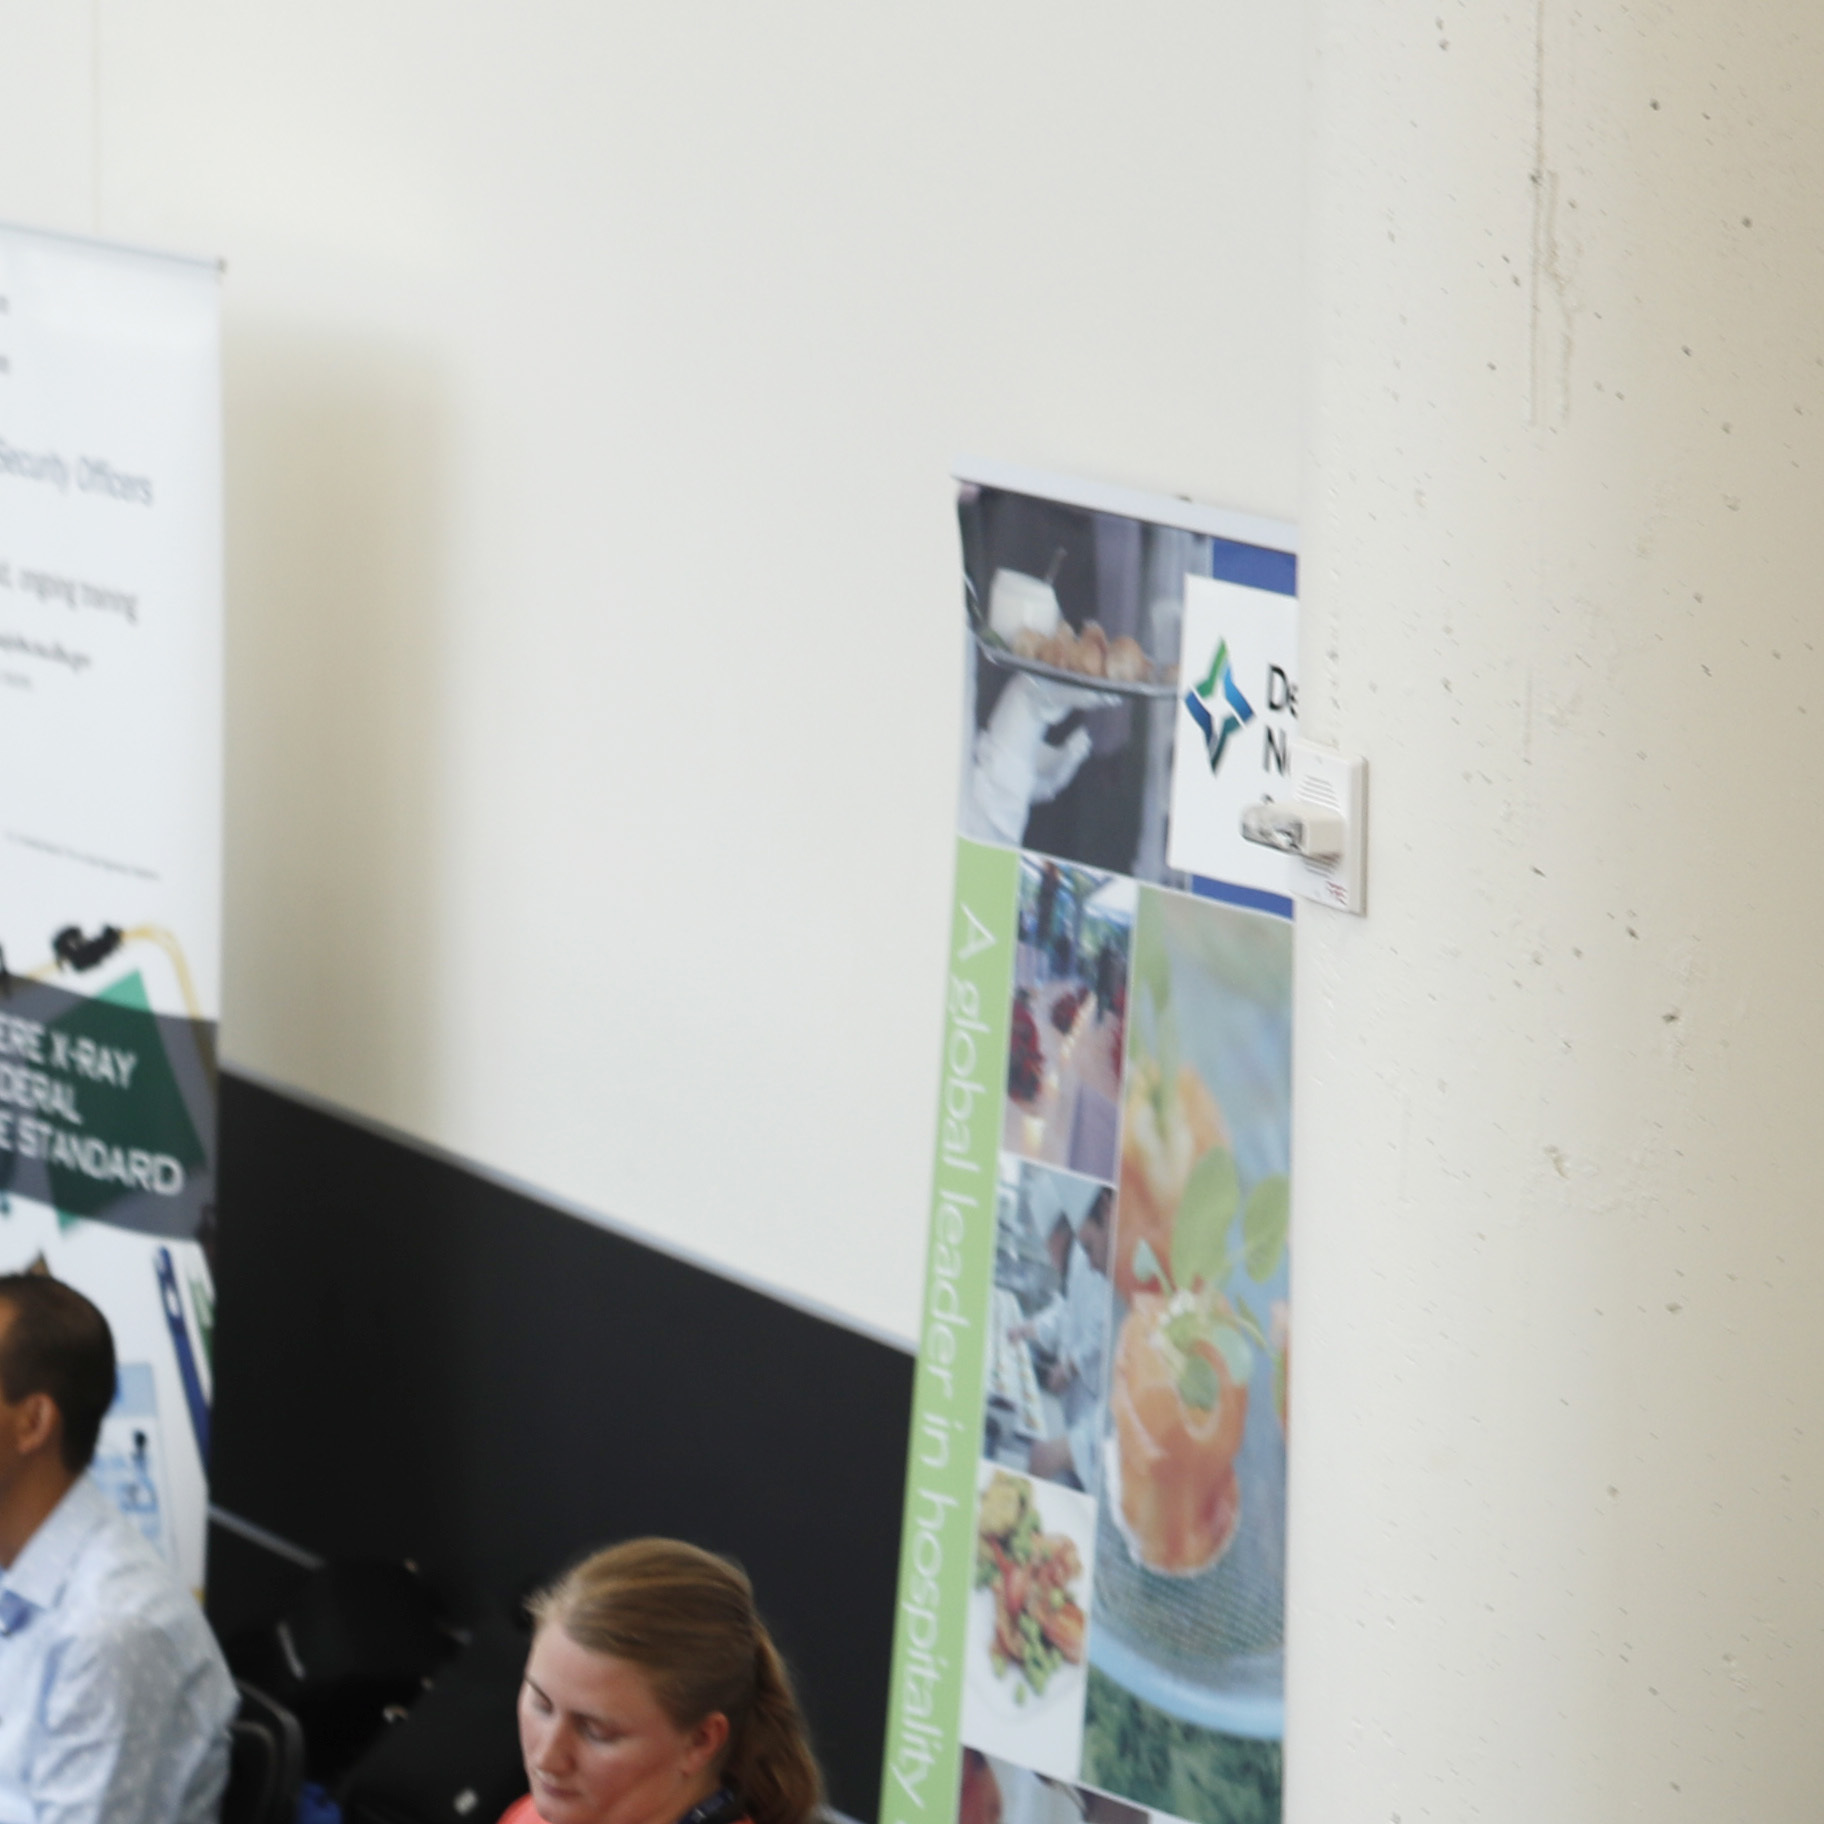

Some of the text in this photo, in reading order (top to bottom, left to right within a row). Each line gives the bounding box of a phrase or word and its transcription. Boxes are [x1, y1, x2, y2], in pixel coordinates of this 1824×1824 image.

[957, 901, 997, 961] A
[942, 973, 991, 1173] global
[16, 1112, 185, 1198] STANDARD
[925, 1188, 980, 1400] leader
[921, 1410, 965, 1469] in
[890, 1484, 960, 1809] hospitality
